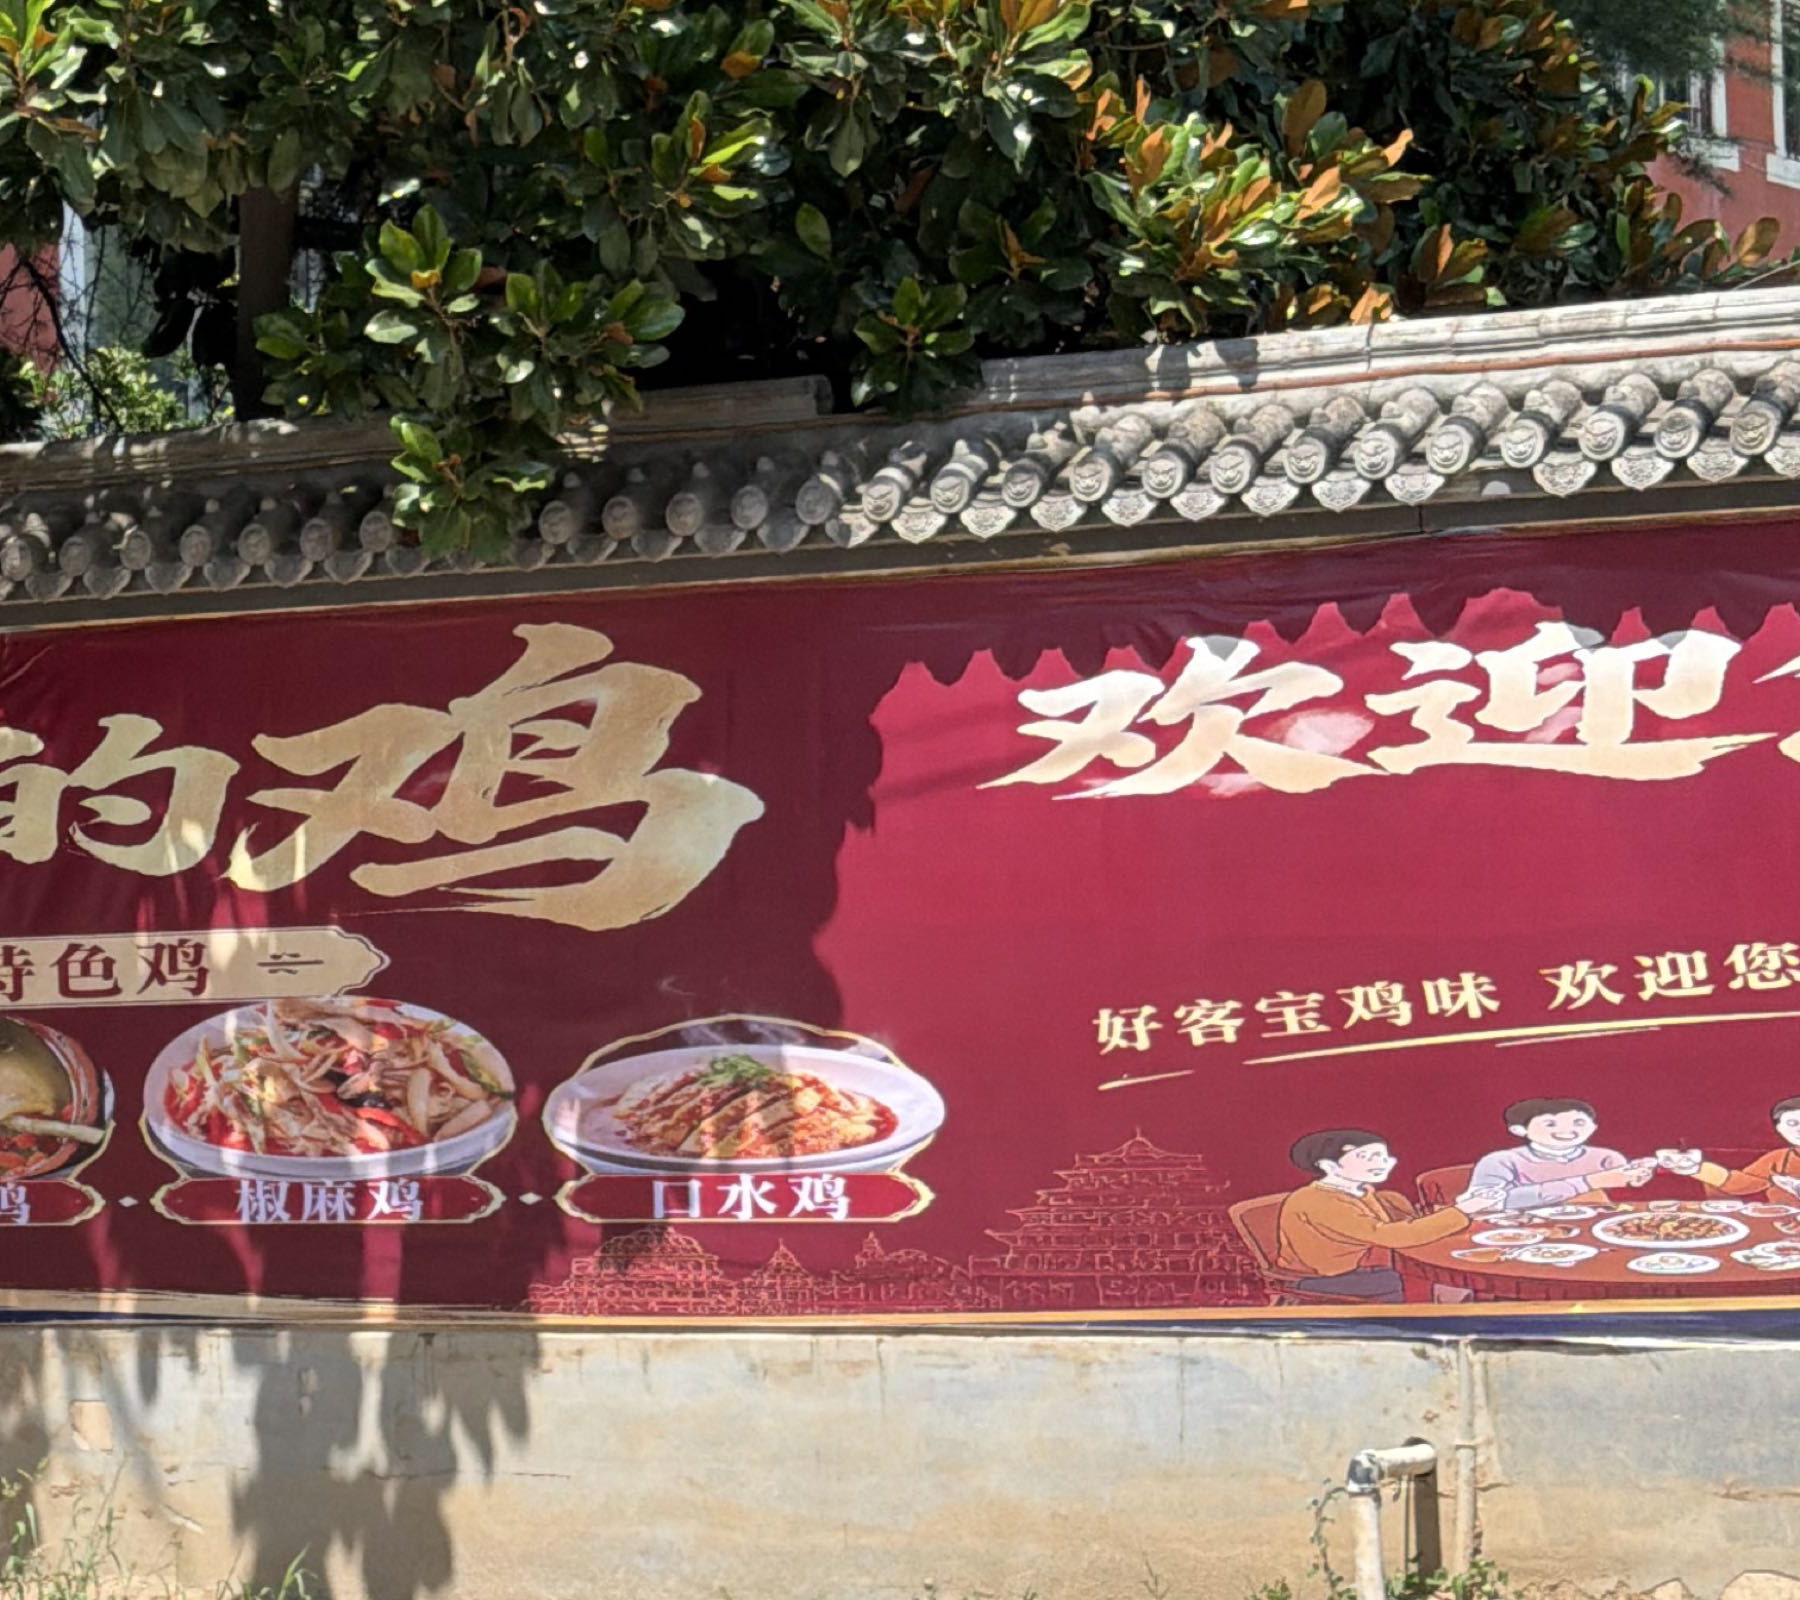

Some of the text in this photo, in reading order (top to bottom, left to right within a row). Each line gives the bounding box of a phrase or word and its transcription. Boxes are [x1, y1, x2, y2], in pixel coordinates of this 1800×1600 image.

[975, 620, 1800, 801] 欢迎
[1092, 941, 1800, 1056] 好客宝鸡味 欢迎您
[236, 1176, 424, 1222] 椒麻鸡
[651, 1171, 850, 1219] 口水鸡
